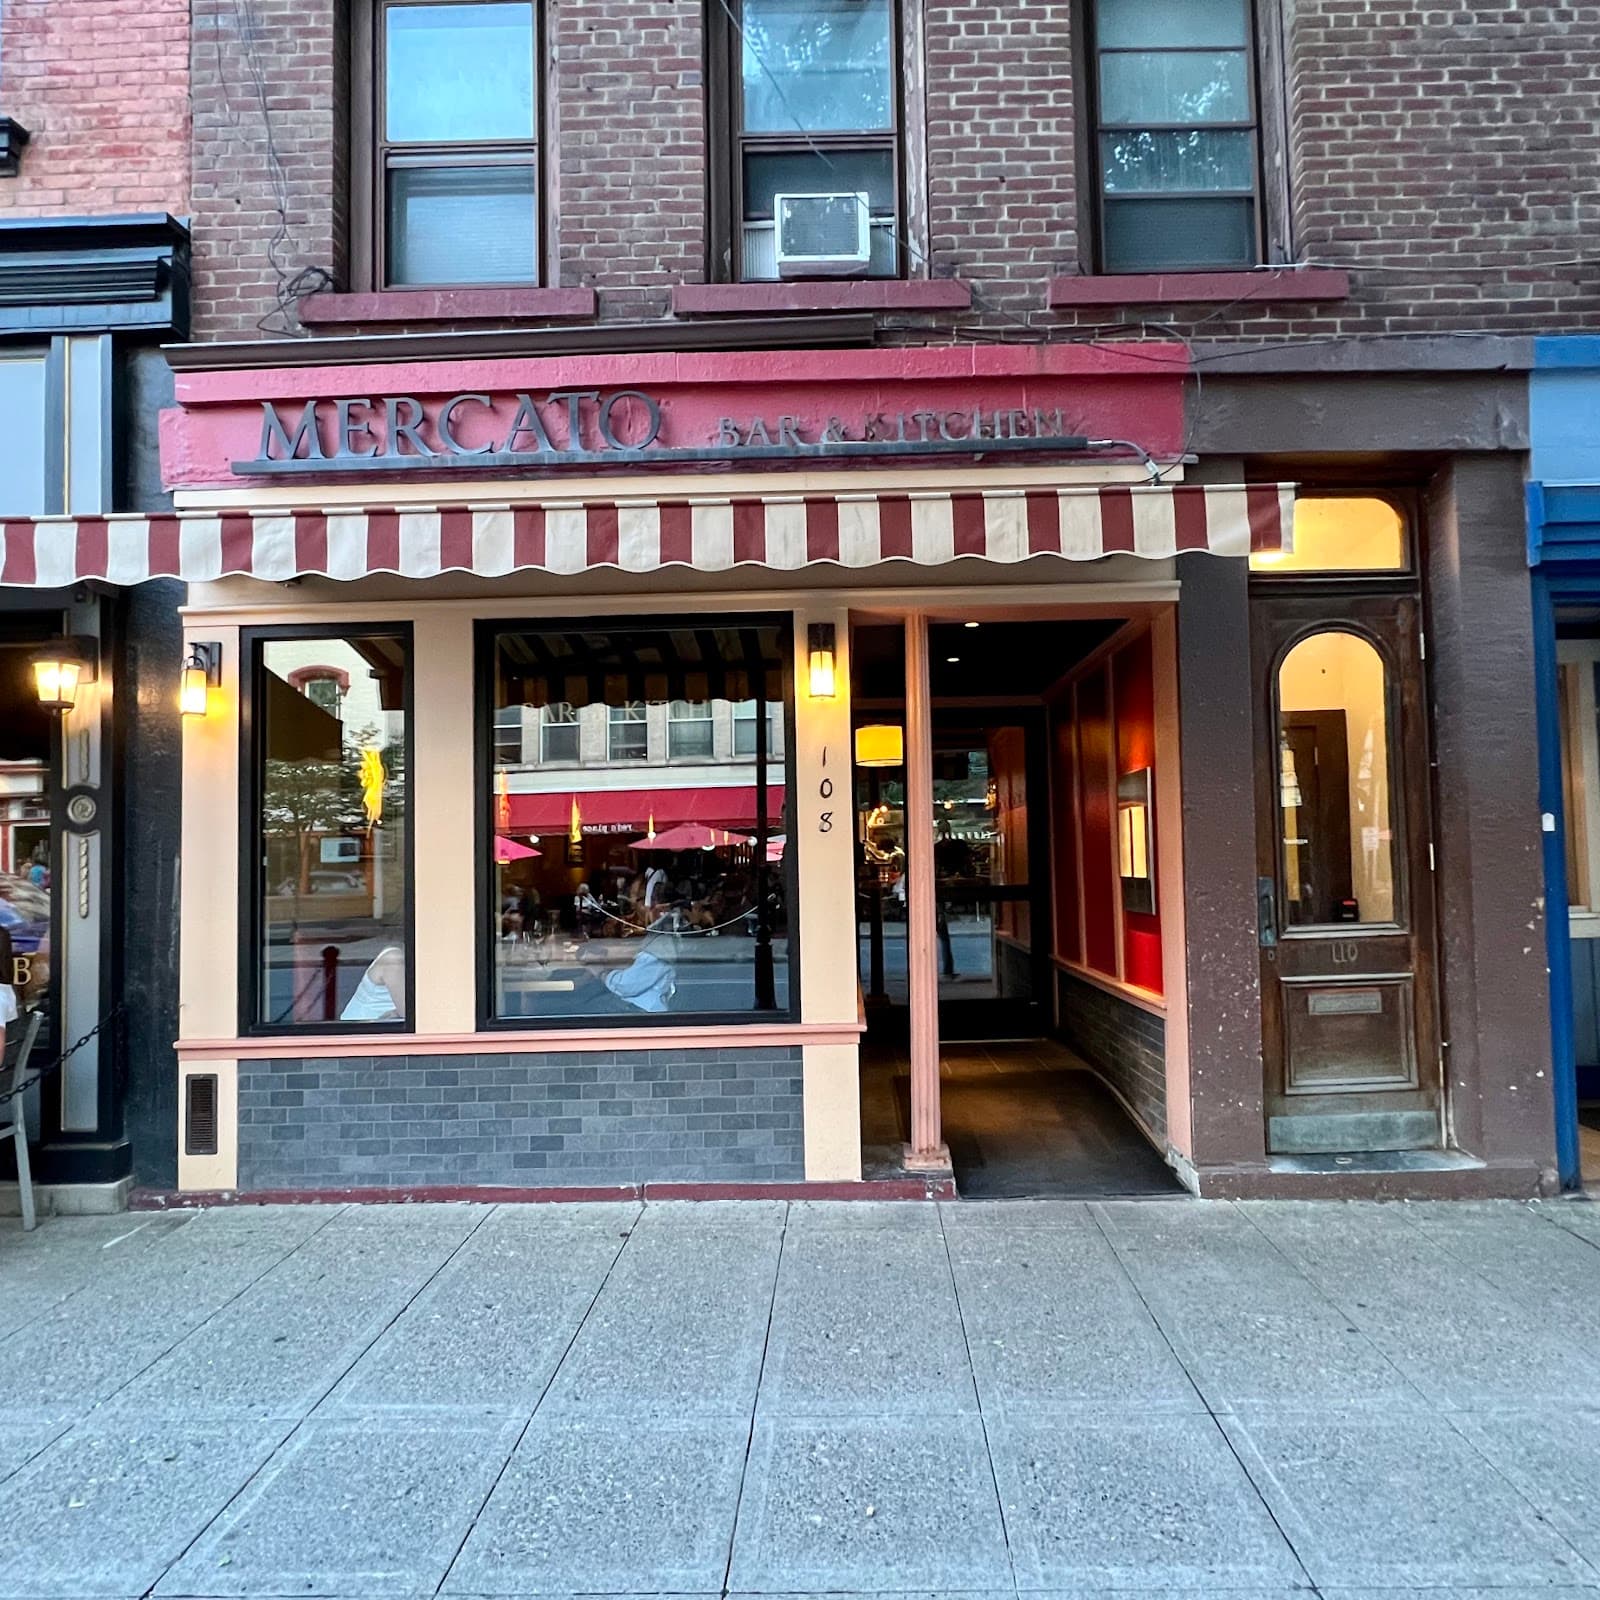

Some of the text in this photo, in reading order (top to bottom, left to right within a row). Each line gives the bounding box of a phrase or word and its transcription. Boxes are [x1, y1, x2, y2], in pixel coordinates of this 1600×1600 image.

[256, 390, 1065, 460] MERCATO BAR & KITCHEN
[819, 745, 833, 833] 108
